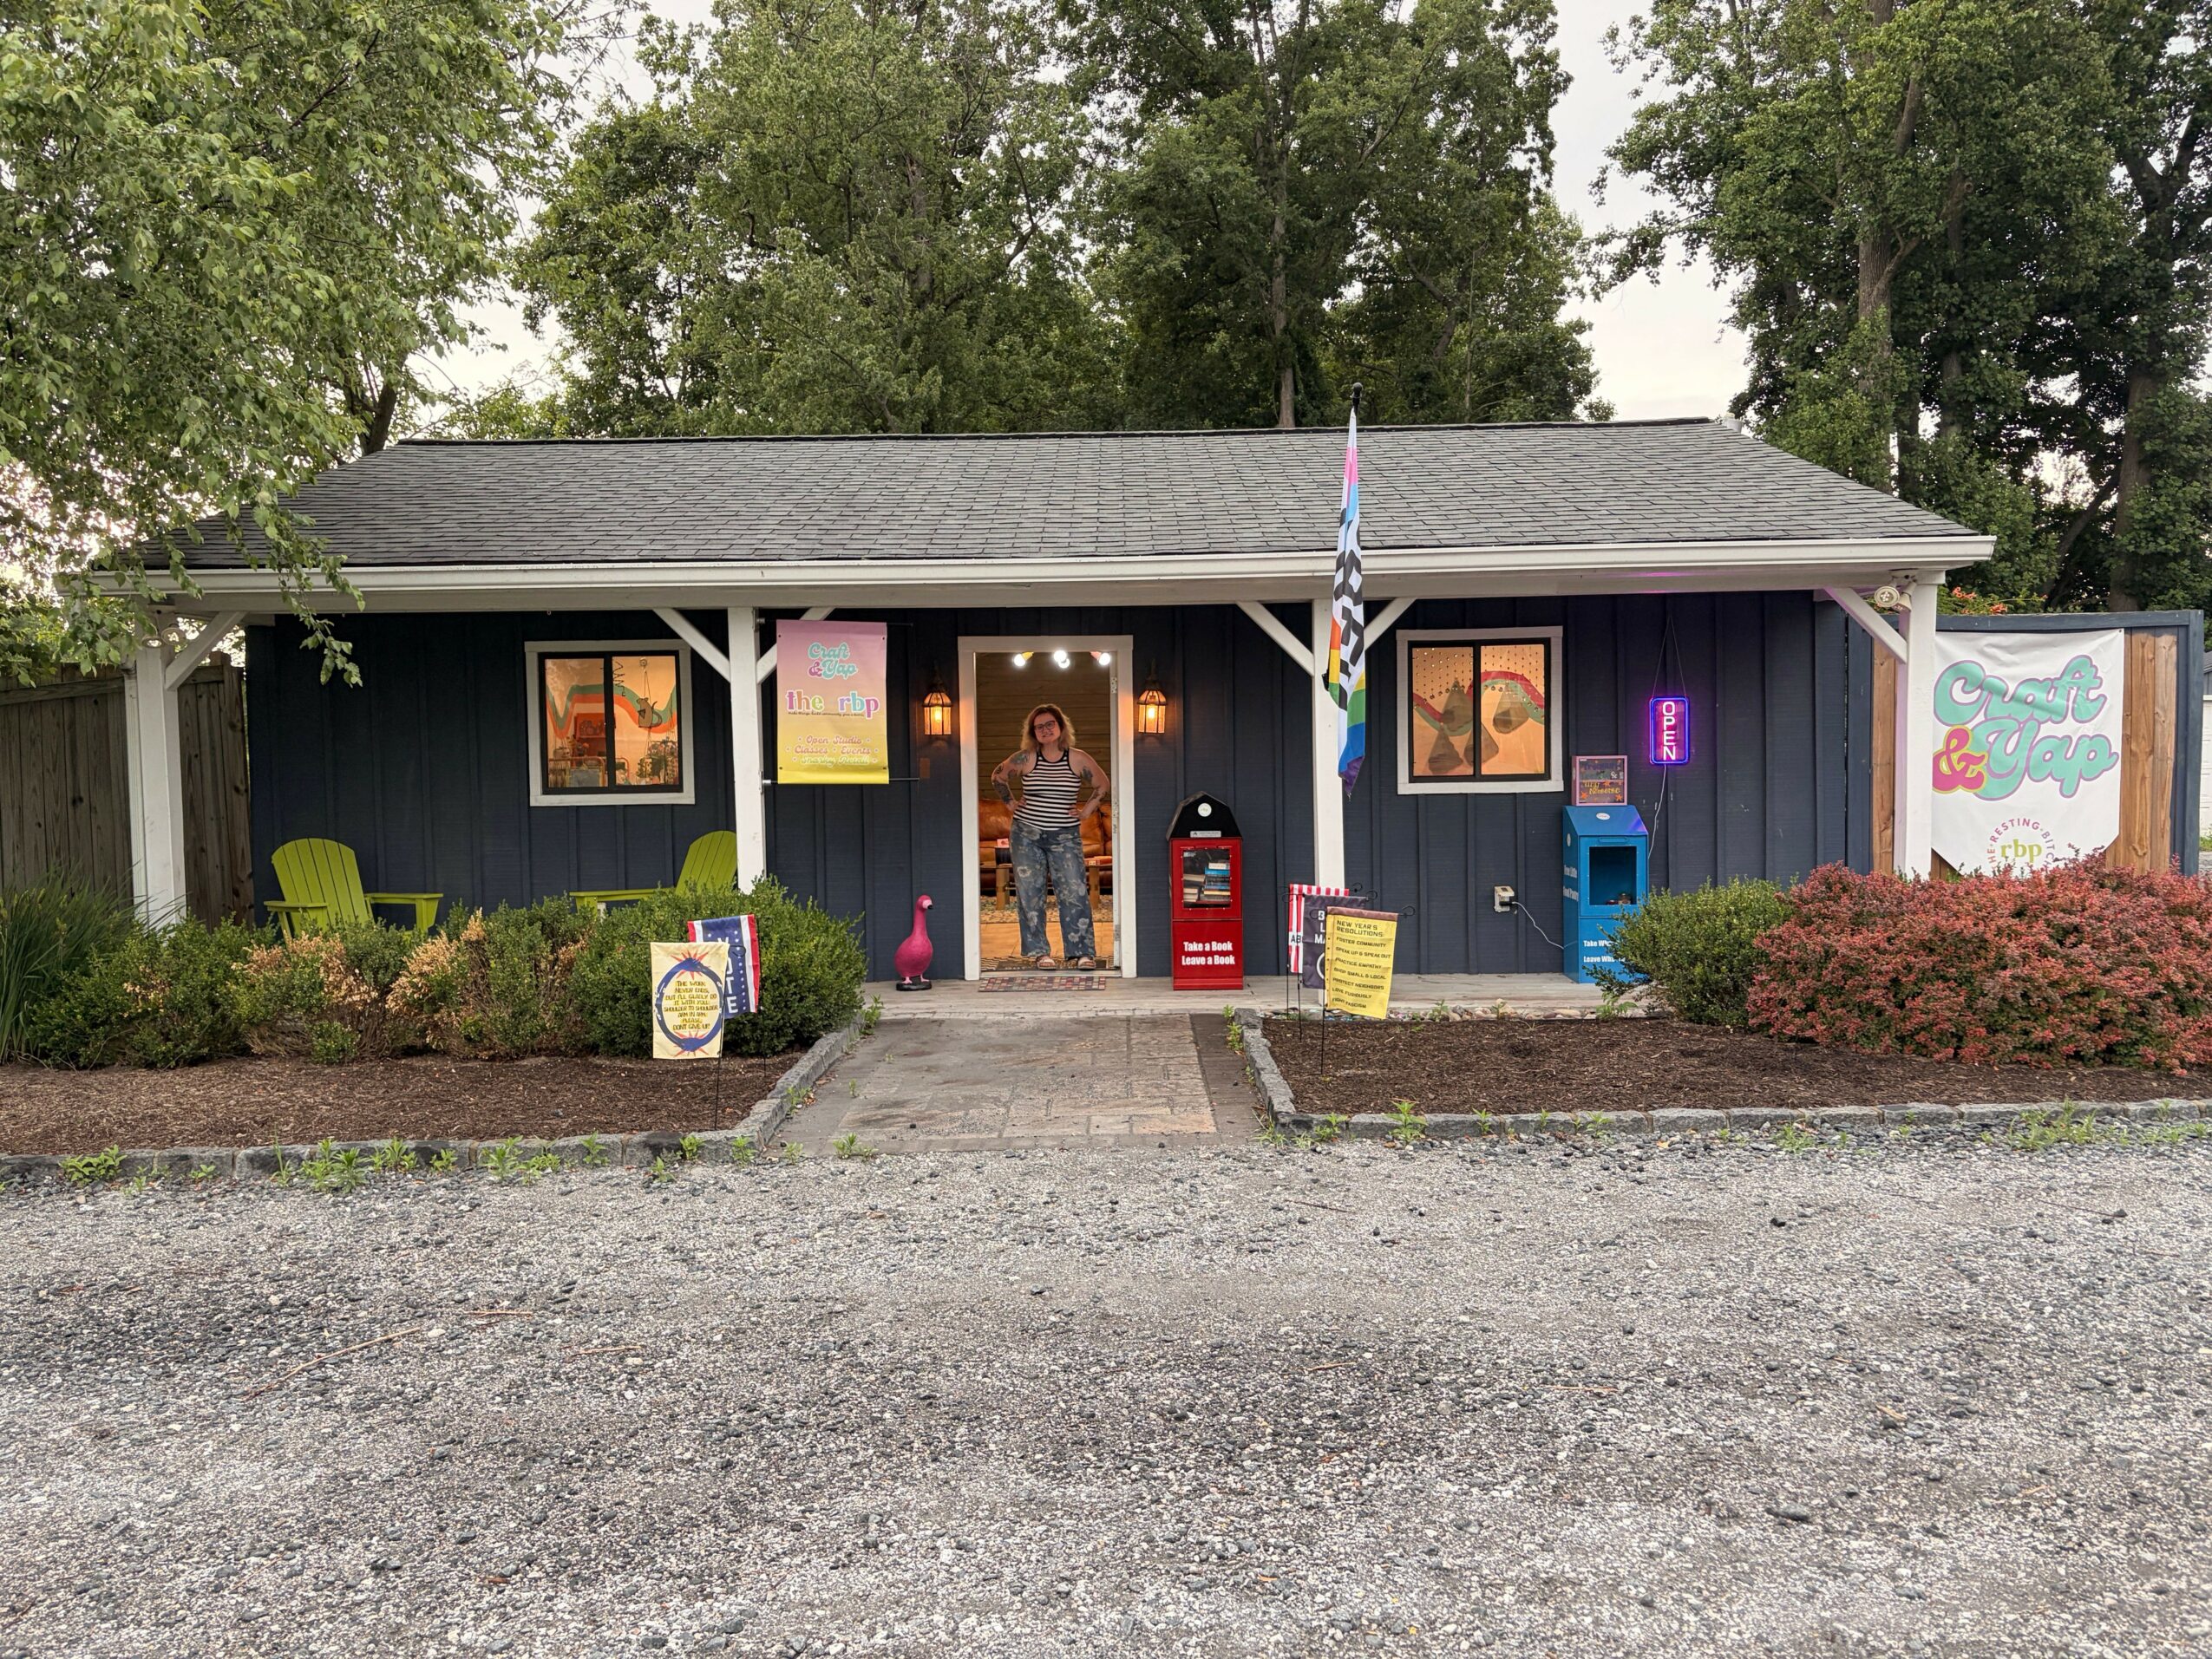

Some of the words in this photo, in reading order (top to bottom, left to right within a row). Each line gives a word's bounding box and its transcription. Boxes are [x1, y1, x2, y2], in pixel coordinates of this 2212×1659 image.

[808, 642, 850, 660] Craft
[808, 661, 822, 678] &
[821, 659, 857, 679] Yap
[1934, 655, 2108, 726] Craft
[786, 689, 824, 711] the
[839, 690, 880, 719] rbp
[1662, 701, 1676, 761] OPEN
[795, 745, 828, 754] Classes
[841, 746, 871, 754] Events
[806, 735, 829, 746] Open
[833, 735, 862, 745] Studio
[1932, 725, 1987, 794] &
[1970, 716, 2120, 801] Yap
[1989, 818, 2040, 843] RESTING
[2041, 831, 2055, 867] BITCH
[2000, 839, 2043, 864] rbp
[1183, 941, 1204, 951] Take
[1211, 941, 1234, 951] Book
[1181, 956, 1206, 966] Leave
[1207, 957, 1213, 966] a
[1214, 955, 1235, 965] Book
[1335, 957, 1358, 966] PRACTICE
[1332, 977, 1355, 987] PROTECT
[1345, 990, 1372, 999] FURIOUSLY
